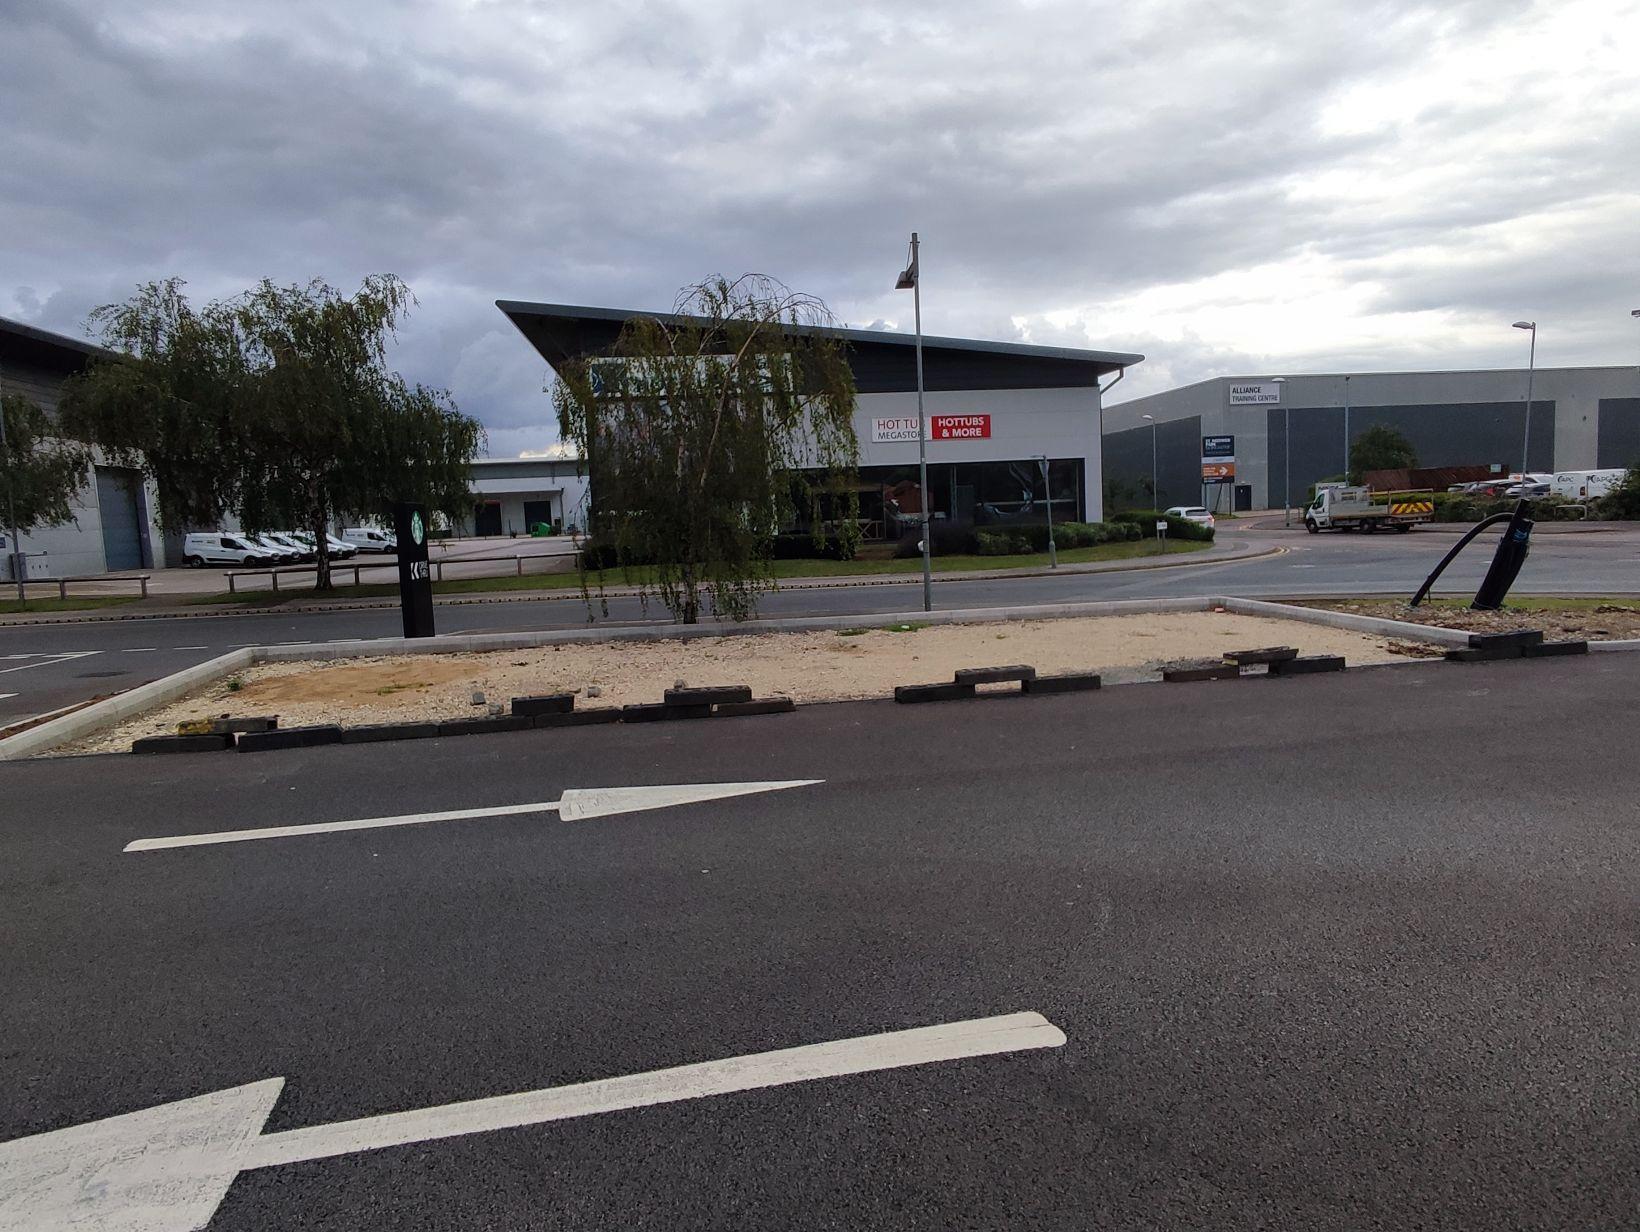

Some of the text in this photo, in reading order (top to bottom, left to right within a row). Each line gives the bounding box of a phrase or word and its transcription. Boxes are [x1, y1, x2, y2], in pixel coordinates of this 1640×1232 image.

[1232, 386, 1262, 394] ALLIANCE
[877, 419, 925, 430] HOT TU
[938, 416, 985, 427] HOTTUBS
[941, 427, 982, 438] & MORE
